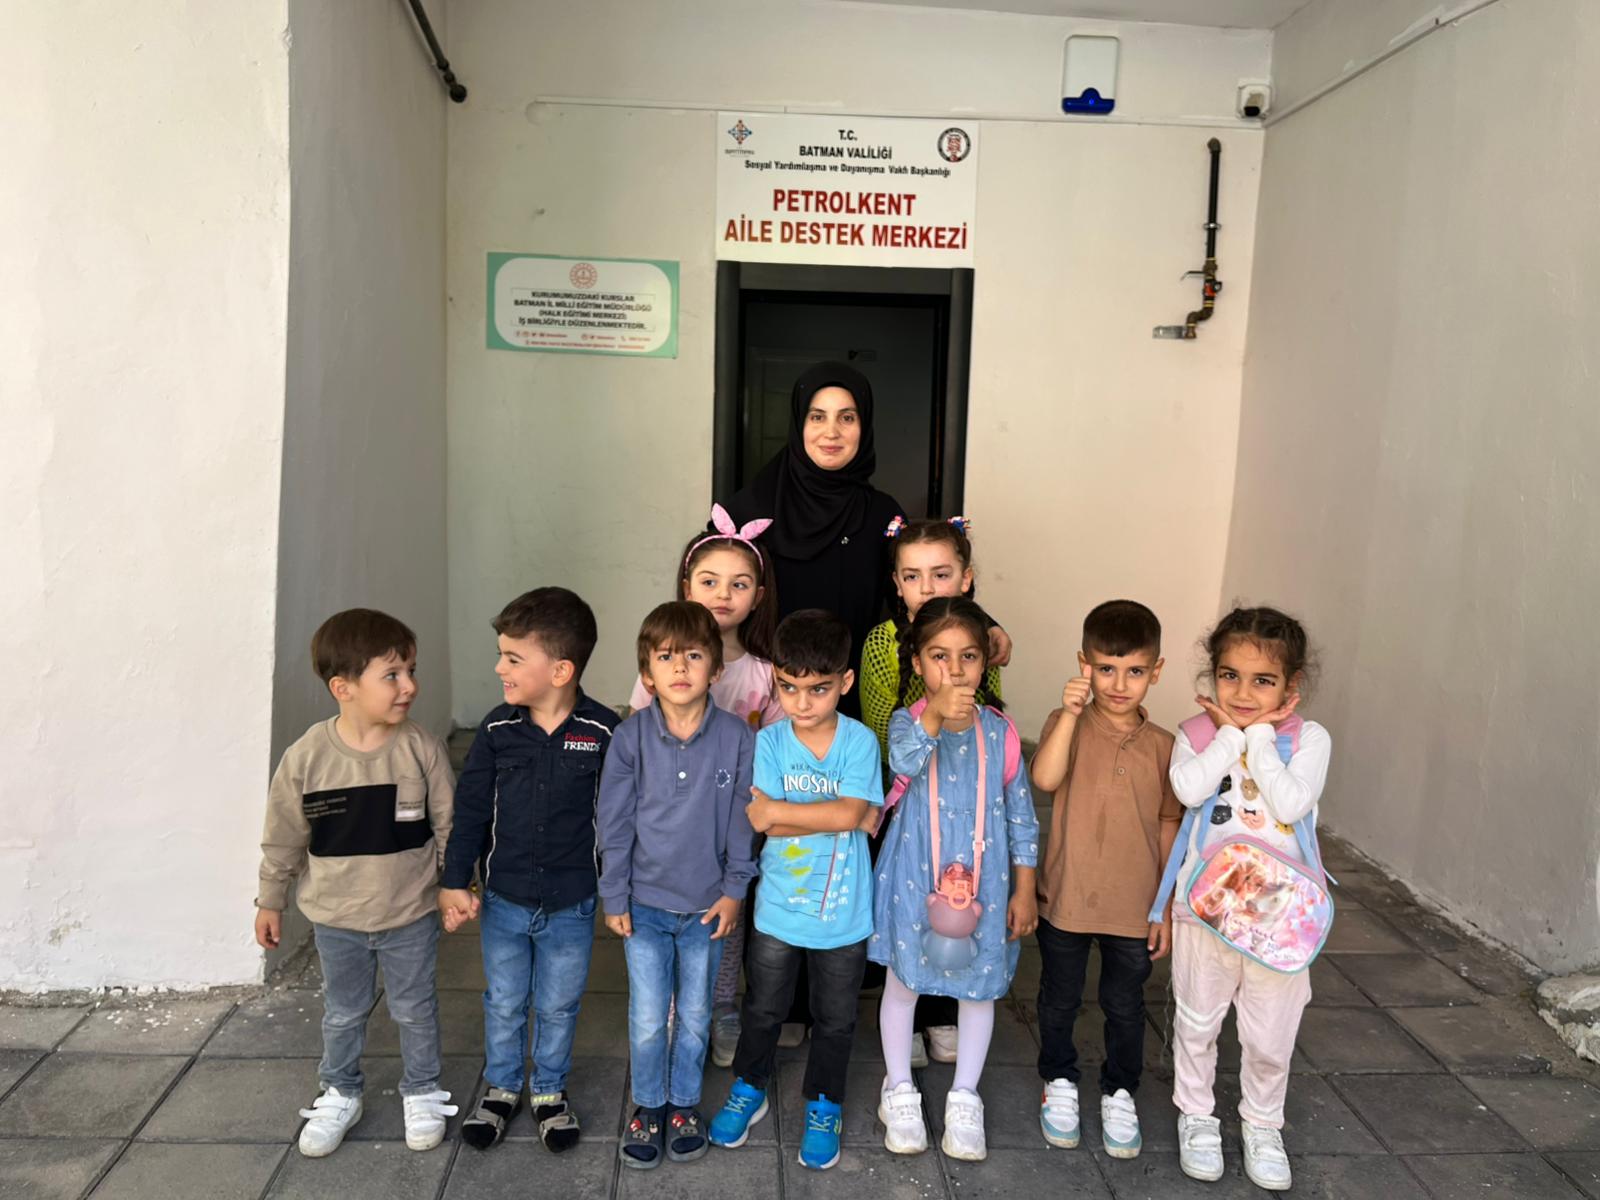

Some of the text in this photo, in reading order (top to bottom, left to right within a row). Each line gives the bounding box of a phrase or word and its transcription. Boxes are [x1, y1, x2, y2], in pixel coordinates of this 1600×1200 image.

[838, 129, 858, 141] T.C.
[799, 145, 893, 160] BATMAN VALİLİĞİ
[745, 160, 772, 171] Sosyal
[774, 161, 826, 173] Yardımlaşma
[829, 164, 838, 172] ve
[840, 163, 885, 175] Dayanışma
[910, 166, 952, 178] Başkanlığı
[773, 189, 917, 216] PETROLKENT
[724, 214, 968, 250] AİLE DESTEK MERKEZİ
[514, 299, 546, 307] BATMAN
[555, 300, 575, 308] MİLLİ
[603, 302, 653, 312] MÜDÜRLÜĞÜ
[601, 294, 635, 302] KURSLAR
